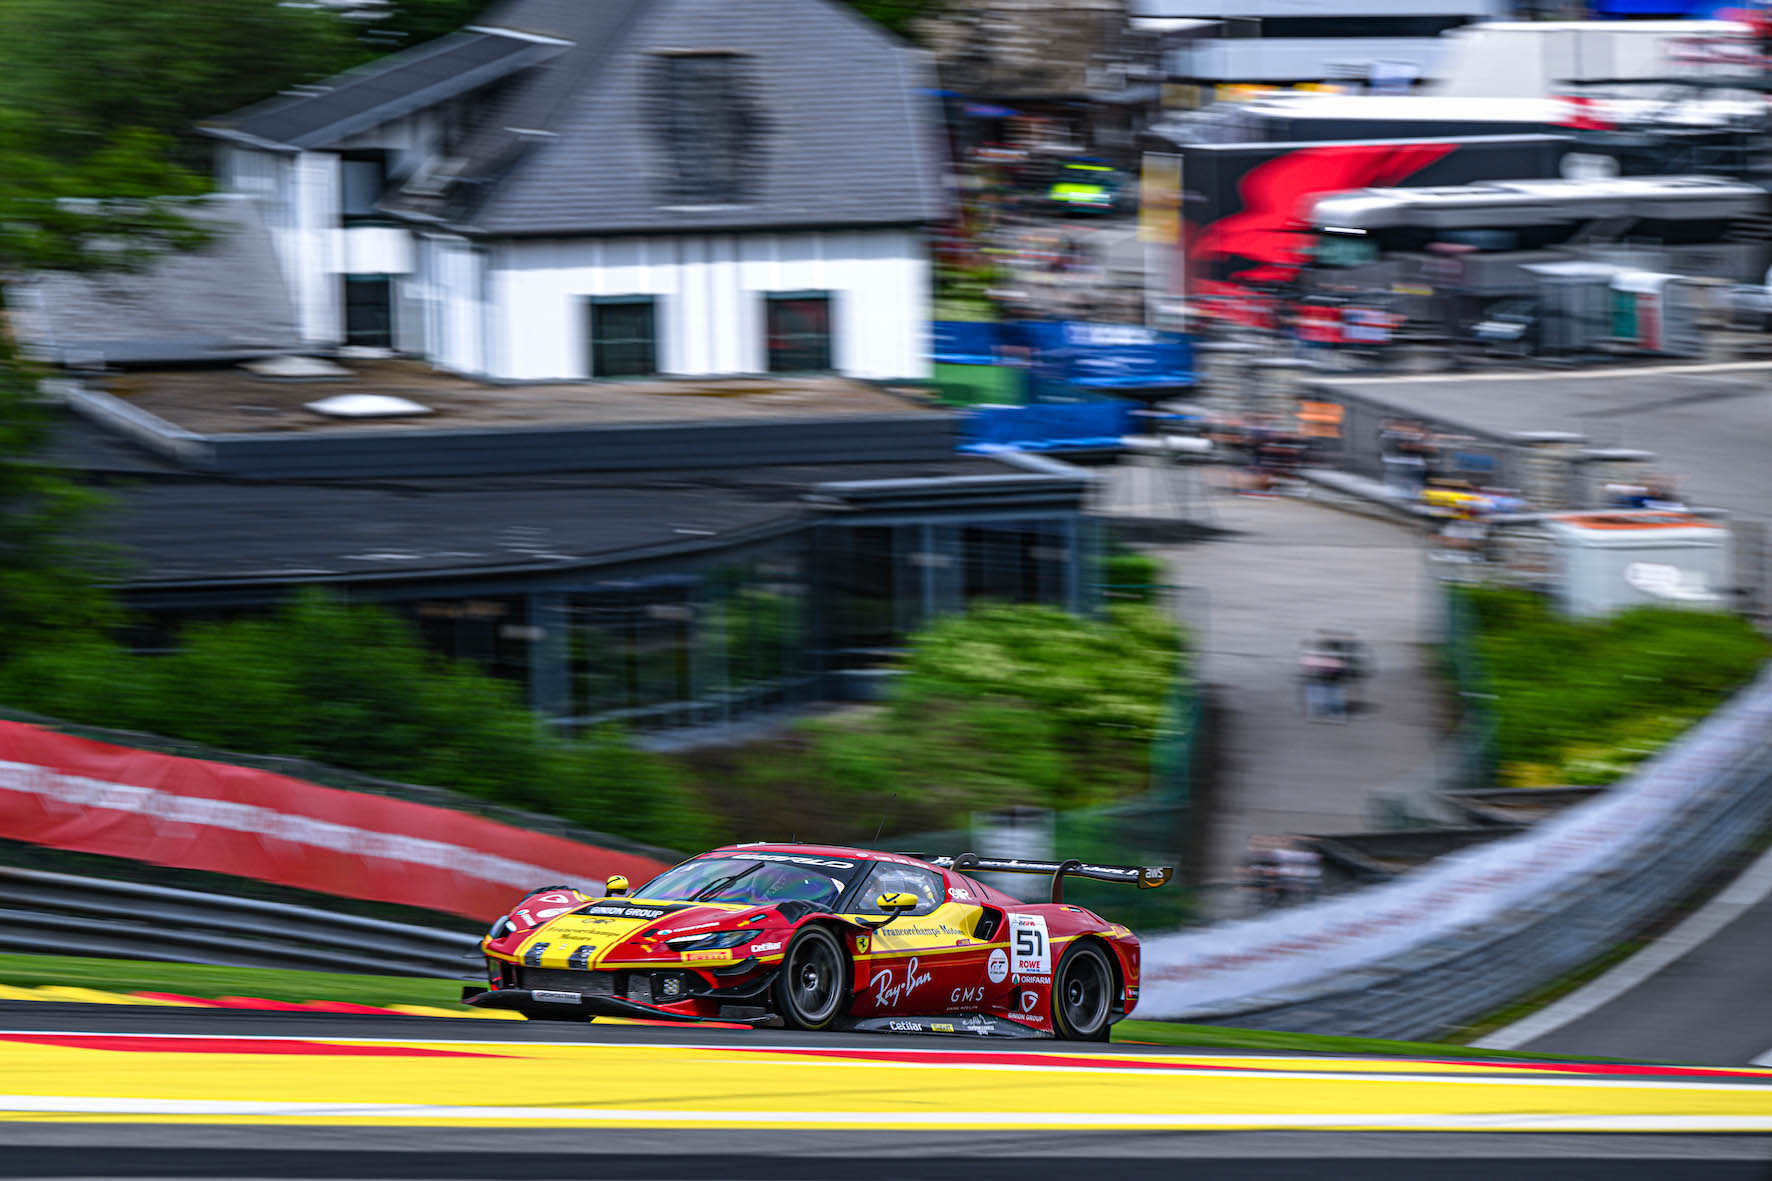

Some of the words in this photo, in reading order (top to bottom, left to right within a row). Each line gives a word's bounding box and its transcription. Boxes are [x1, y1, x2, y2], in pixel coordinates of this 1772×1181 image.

[1145, 867, 1164, 879] aws
[589, 906, 624, 915] GINION
[624, 907, 664, 918] GROUP
[881, 924, 941, 937] Francorchamps
[1017, 930, 1043, 956] 51
[1019, 960, 1041, 969] ROWE
[1021, 976, 1051, 985] ORIFARM
[950, 987, 985, 1003] GMS
[1008, 1012, 1025, 1020] GINION
[1026, 1014, 1044, 1022] GROUP
[889, 1020, 922, 1031] Cetilar
